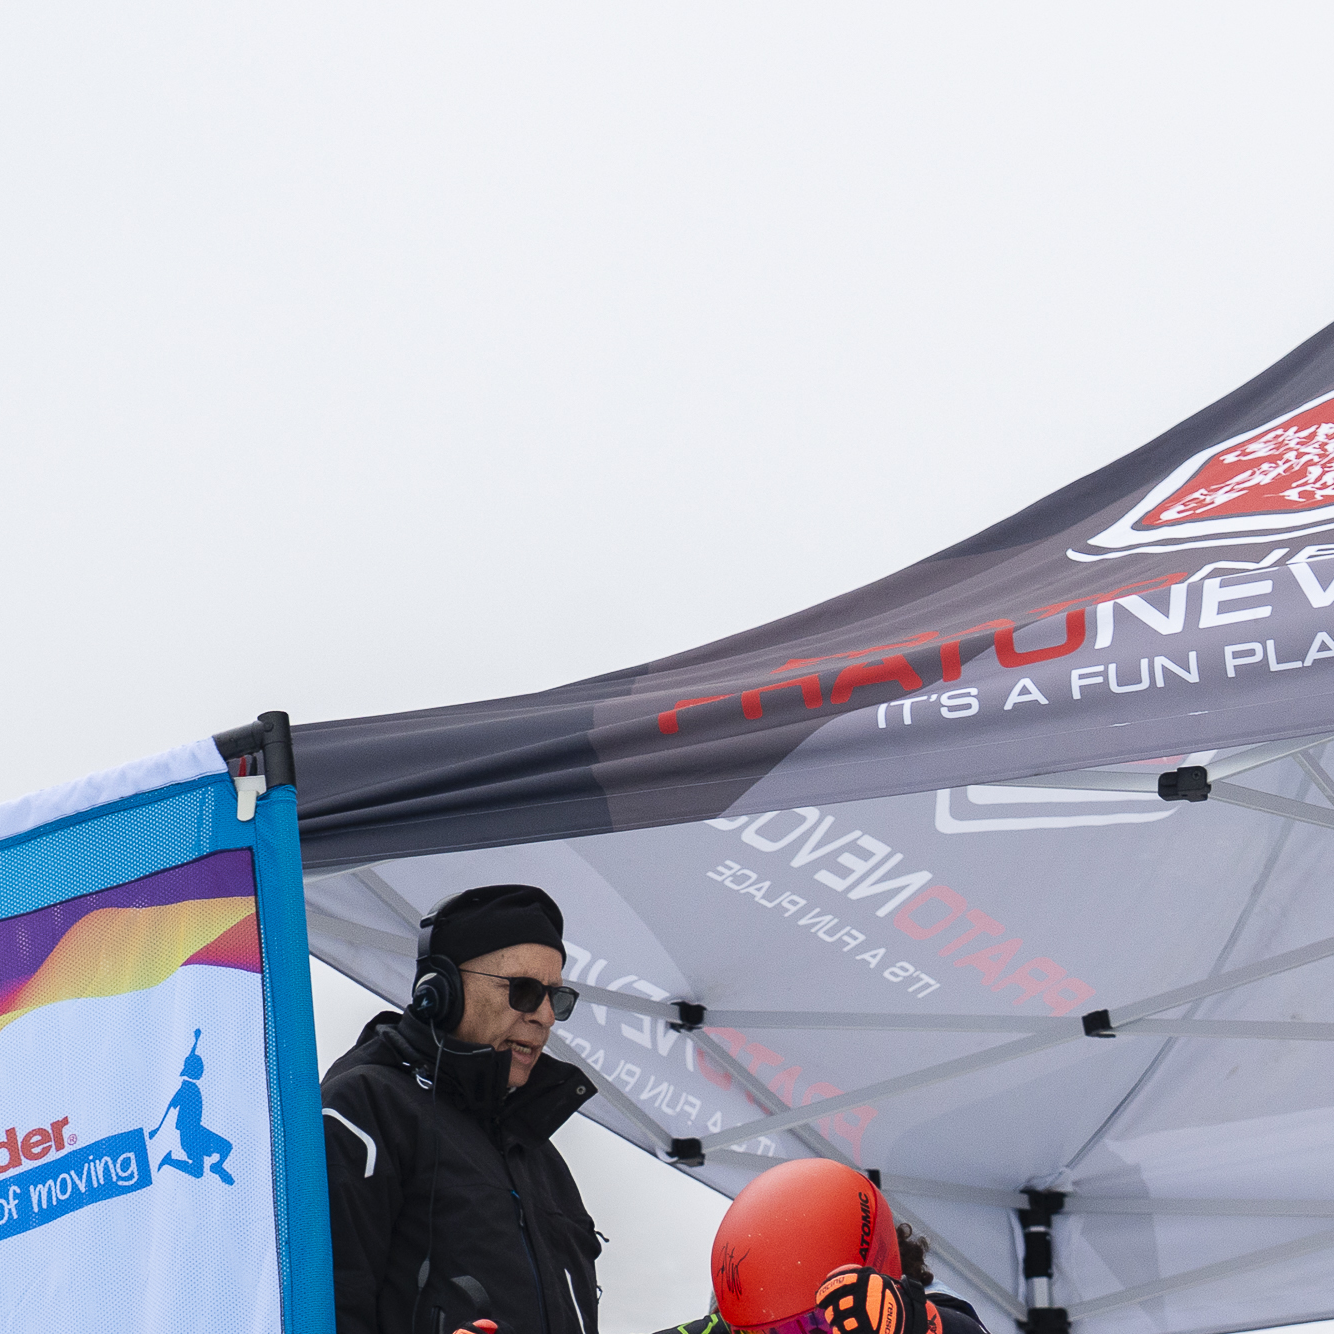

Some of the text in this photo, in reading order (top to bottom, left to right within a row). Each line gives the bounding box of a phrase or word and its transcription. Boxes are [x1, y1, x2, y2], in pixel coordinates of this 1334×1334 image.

[876, 687, 980, 729] IT'S
[1003, 677, 1049, 710] A
[1070, 634, 1201, 701] FUN
[28, 1151, 140, 1213] moving
[858, 1191, 873, 1263] ATOMIC
